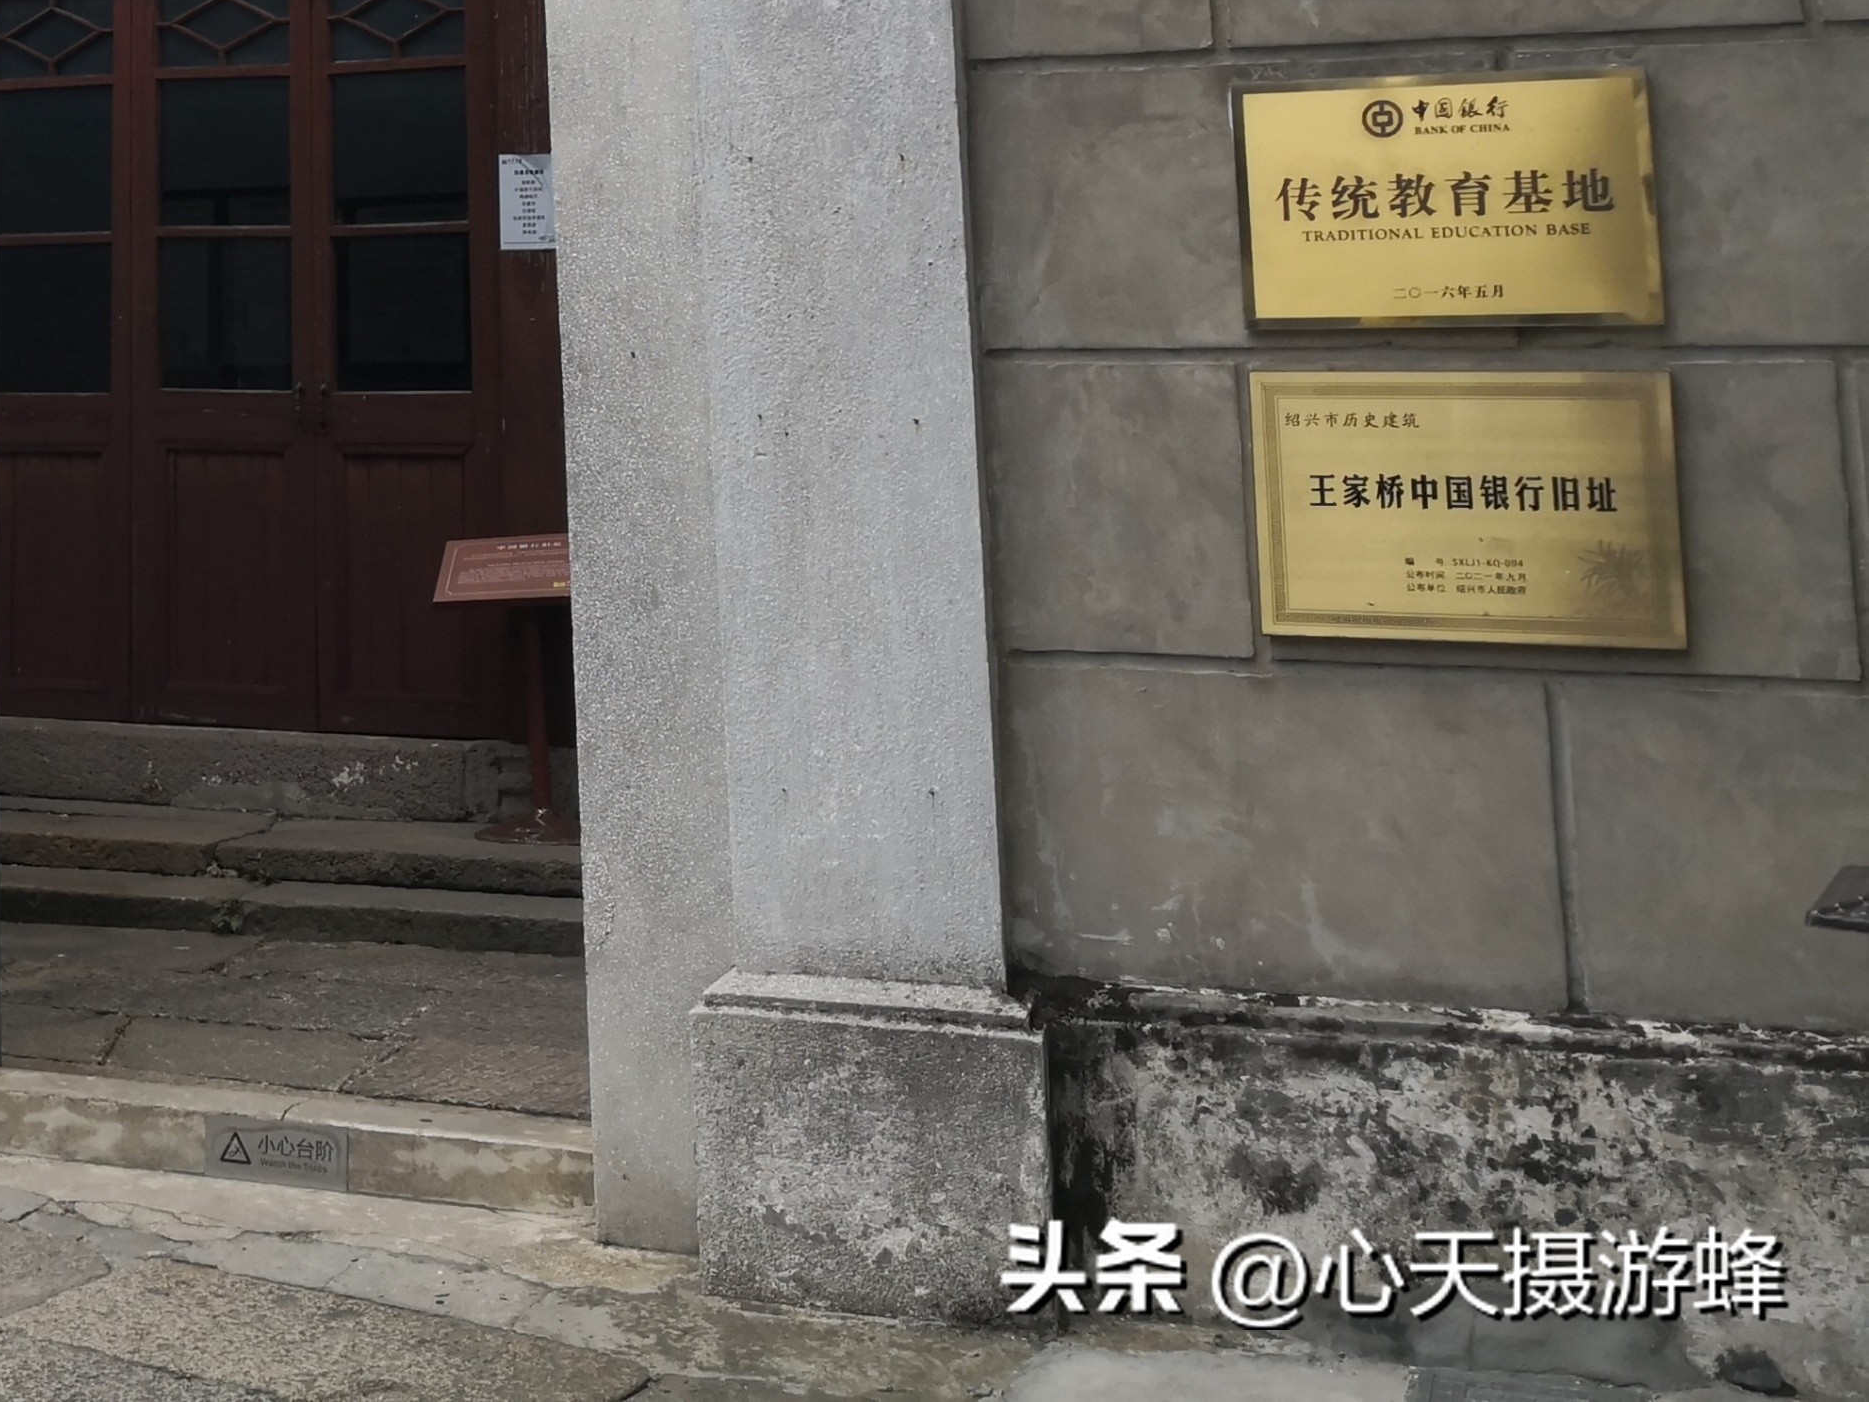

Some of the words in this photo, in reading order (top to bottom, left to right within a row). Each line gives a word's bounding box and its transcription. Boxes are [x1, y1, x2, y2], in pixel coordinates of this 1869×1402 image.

[1415, 125, 1447, 135] BANK
[1450, 124, 1466, 134] OF
[1470, 122, 1510, 133] CHINA
[1276, 167, 1614, 222] 传统教育基地
[1302, 228, 1424, 243] TRADITIONAL
[1431, 224, 1537, 240] EDUCATION
[1547, 222, 1591, 237] BASE
[1284, 411, 1420, 430] 绍兴市历史建筑
[1308, 473, 1618, 512] 王家桥中国银行旧址
[258, 1134, 334, 1162] 小心台阶
